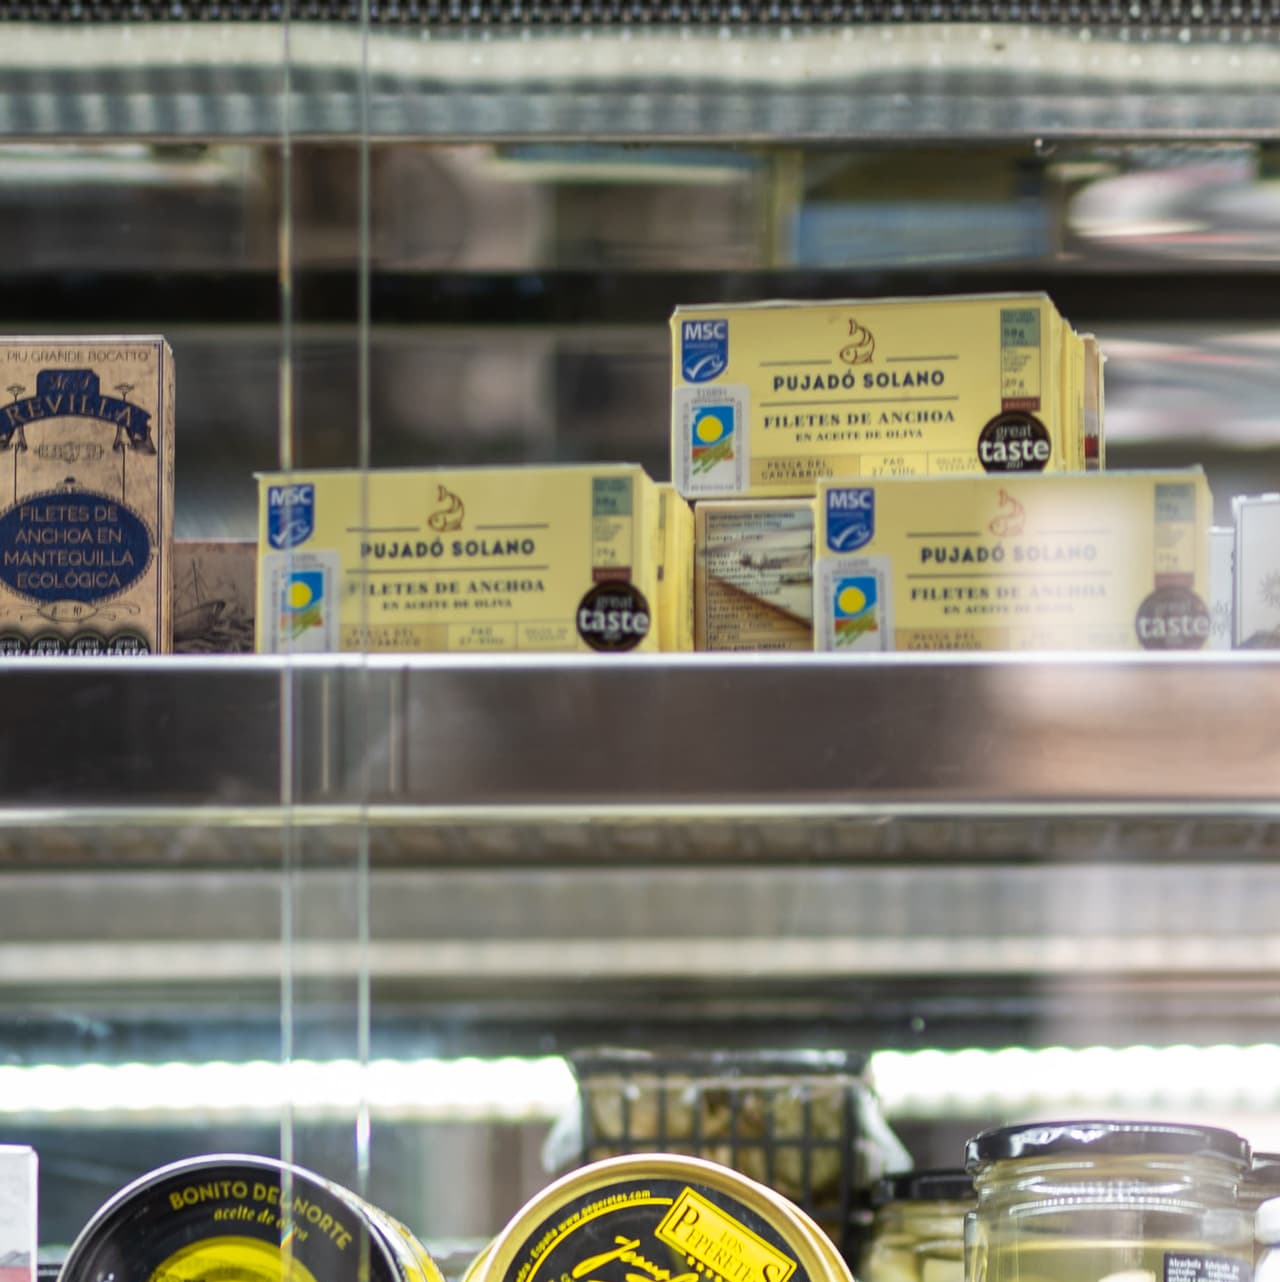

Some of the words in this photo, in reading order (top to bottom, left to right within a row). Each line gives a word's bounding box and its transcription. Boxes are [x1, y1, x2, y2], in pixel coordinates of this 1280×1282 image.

[684, 322, 726, 341] MSC
[773, 369, 855, 393] PUJADÓ
[863, 369, 945, 389] SOLANO
[5, 393, 132, 427] REVILLA
[763, 413, 840, 429] FILETES
[847, 412, 871, 426] DE
[878, 409, 956, 425] ANCHOA
[795, 433, 812, 443] EN
[816, 431, 861, 442] ACEITE
[865, 430, 881, 440] DE
[886, 429, 923, 440] OLIVA
[995, 422, 1032, 442] great
[980, 438, 1050, 463] taste
[829, 490, 872, 510] MSC
[20, 506, 89, 522] FILETES
[95, 506, 118, 522] DE
[14, 527, 92, 545] ANCHOA
[97, 528, 122, 544] EN
[451, 537, 536, 557] SOLANO
[921, 542, 1006, 564] PUJADÓ
[1013, 545, 1097, 561] SOLANO
[3, 550, 135, 569] MANTEQUILLA
[17, 570, 121, 589] ECOLÓGICA
[435, 579, 459, 594] DE
[468, 578, 545, 593] ANCHOA
[911, 587, 989, 601] FILETES
[579, 607, 649, 635] taste
[1138, 615, 1209, 638] taste
[168, 1180, 248, 1211] BONITO
[293, 1196, 353, 1250] NORTE
[213, 1204, 256, 1222] aceite
[257, 1207, 275, 1225] de
[720, 1230, 745, 1254] LOS
